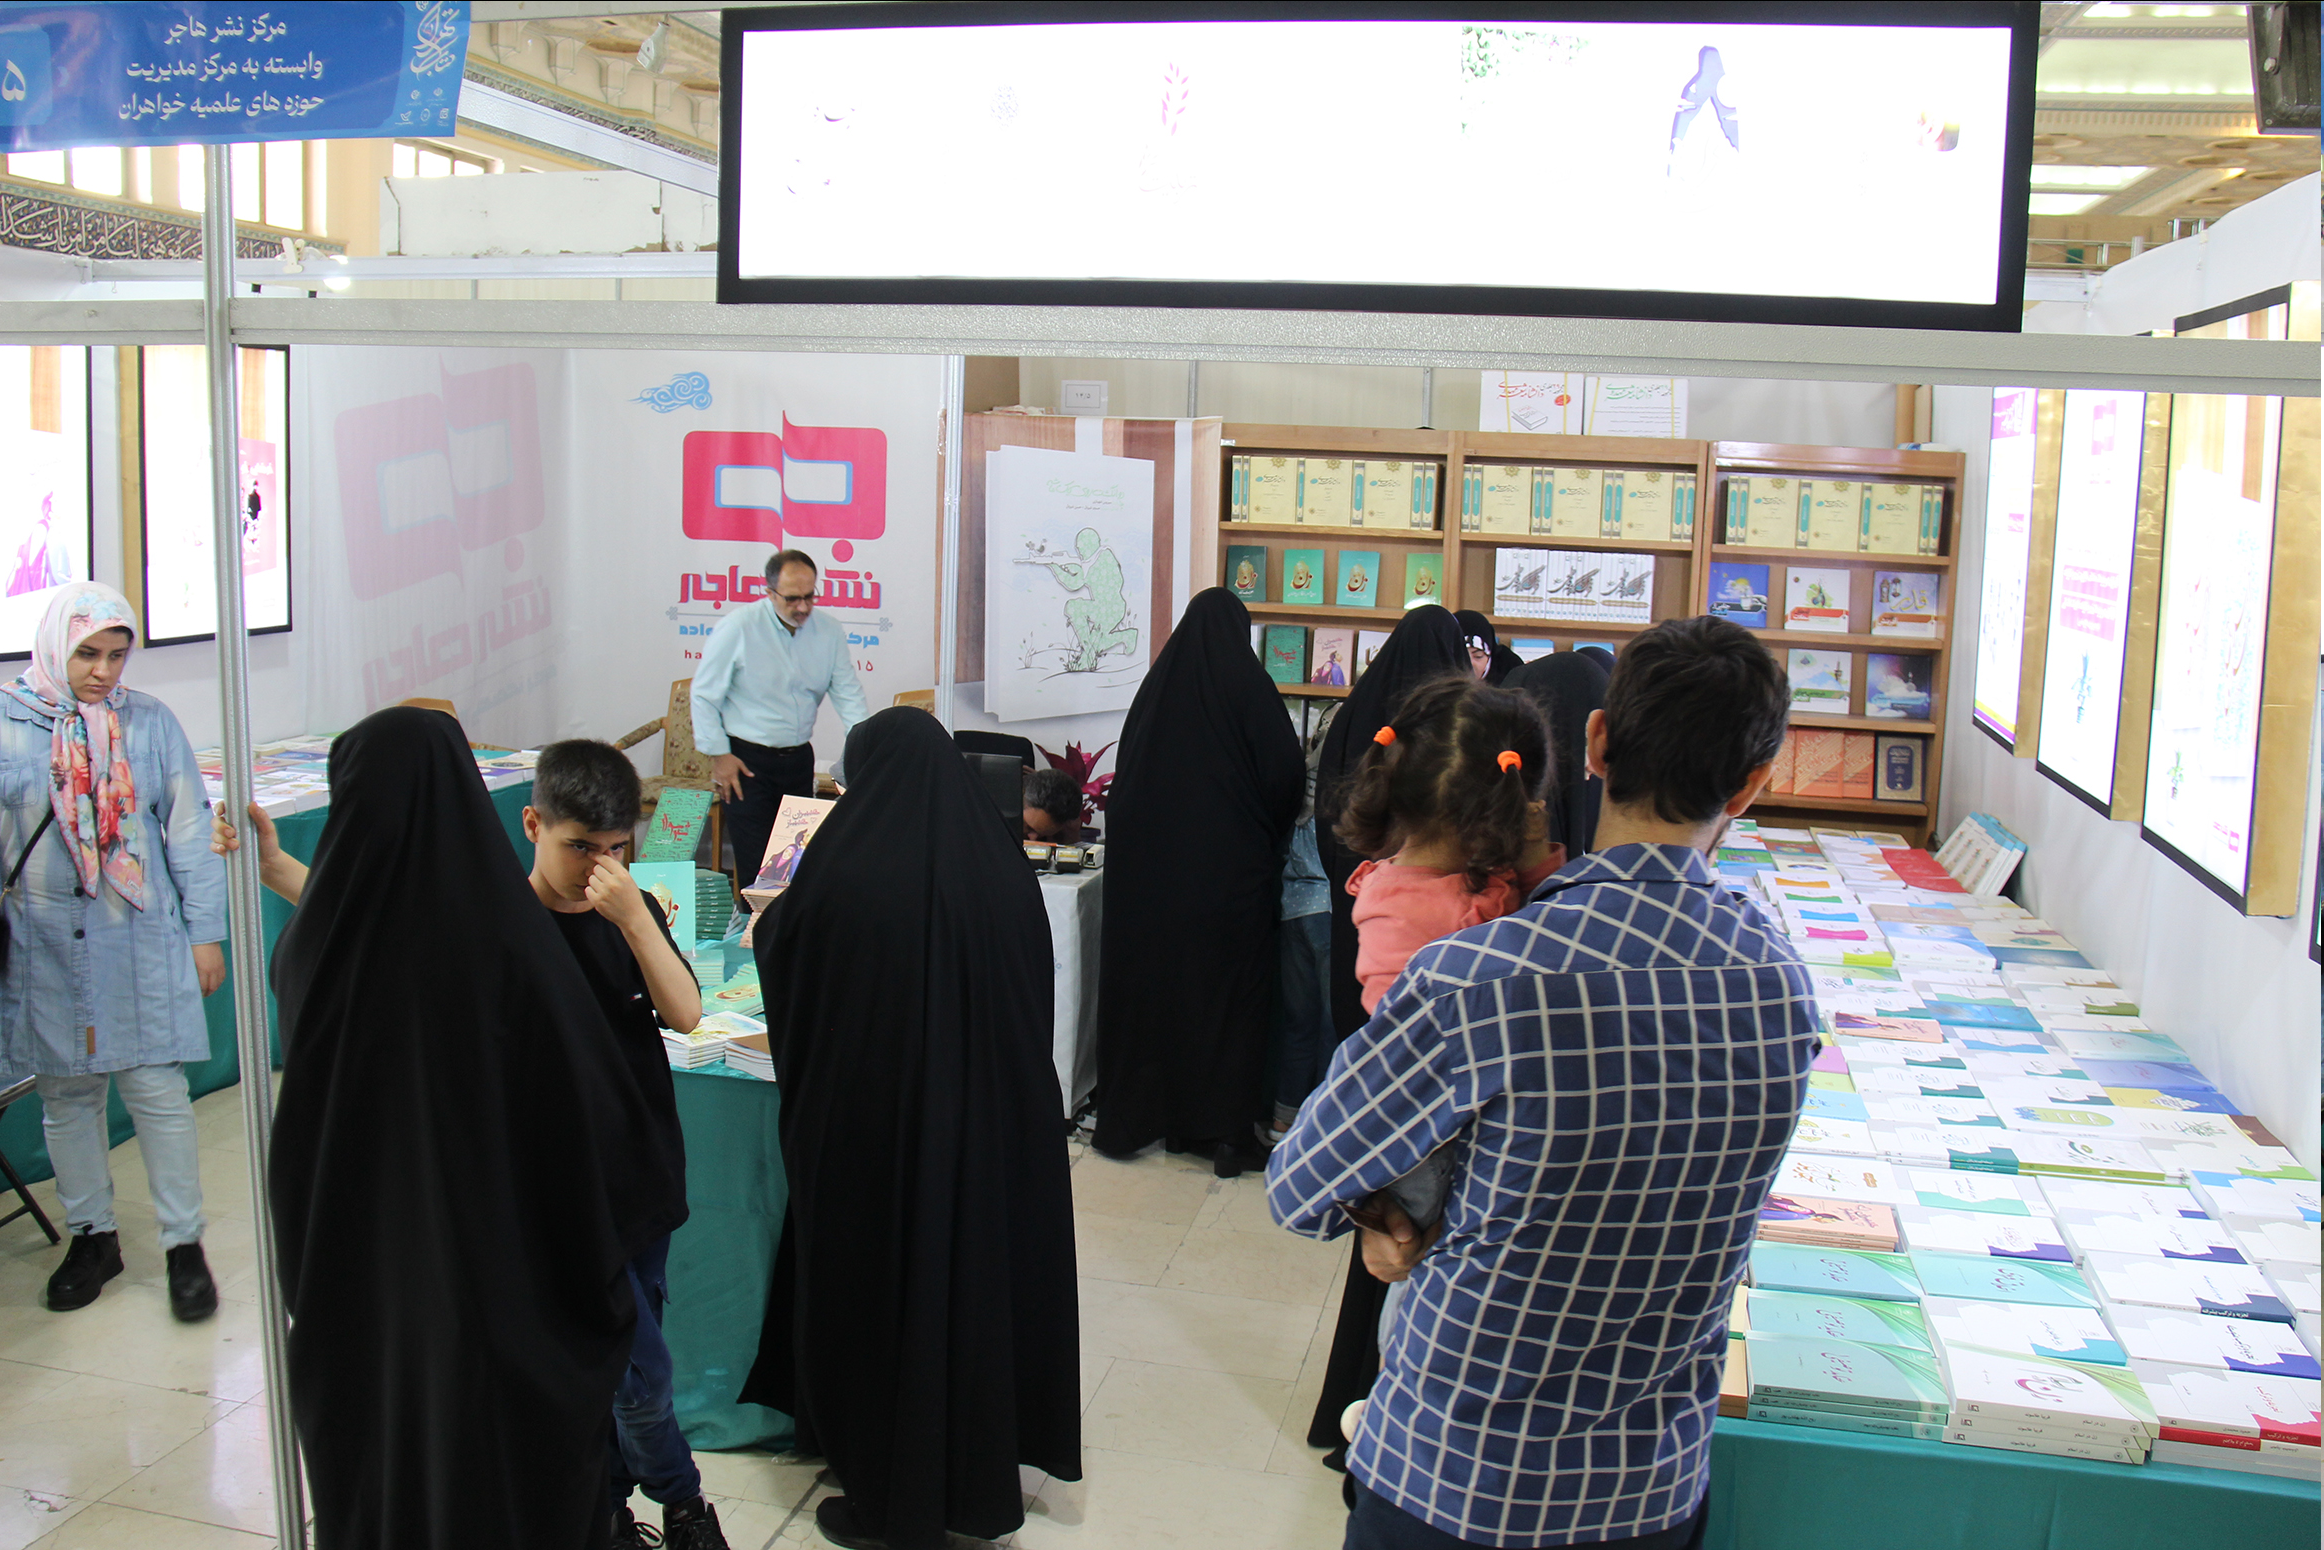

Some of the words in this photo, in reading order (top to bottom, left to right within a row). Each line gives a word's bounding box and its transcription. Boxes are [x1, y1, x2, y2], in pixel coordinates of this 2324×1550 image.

[165, 15, 207, 45] هاجر
[210, 16, 245, 43] نشر
[247, 13, 287, 42] مرکز
[126, 60, 196, 83] مدیریت
[199, 52, 237, 81] مرکز
[241, 60, 259, 81] به
[263, 51, 324, 80] وابسته
[118, 98, 186, 121] خواهران
[190, 97, 242, 118] علمیه
[246, 91, 280, 117] های
[284, 93, 325, 118] حوزه
[813, 566, 882, 610] نش
[847, 631, 880, 650] مرک
